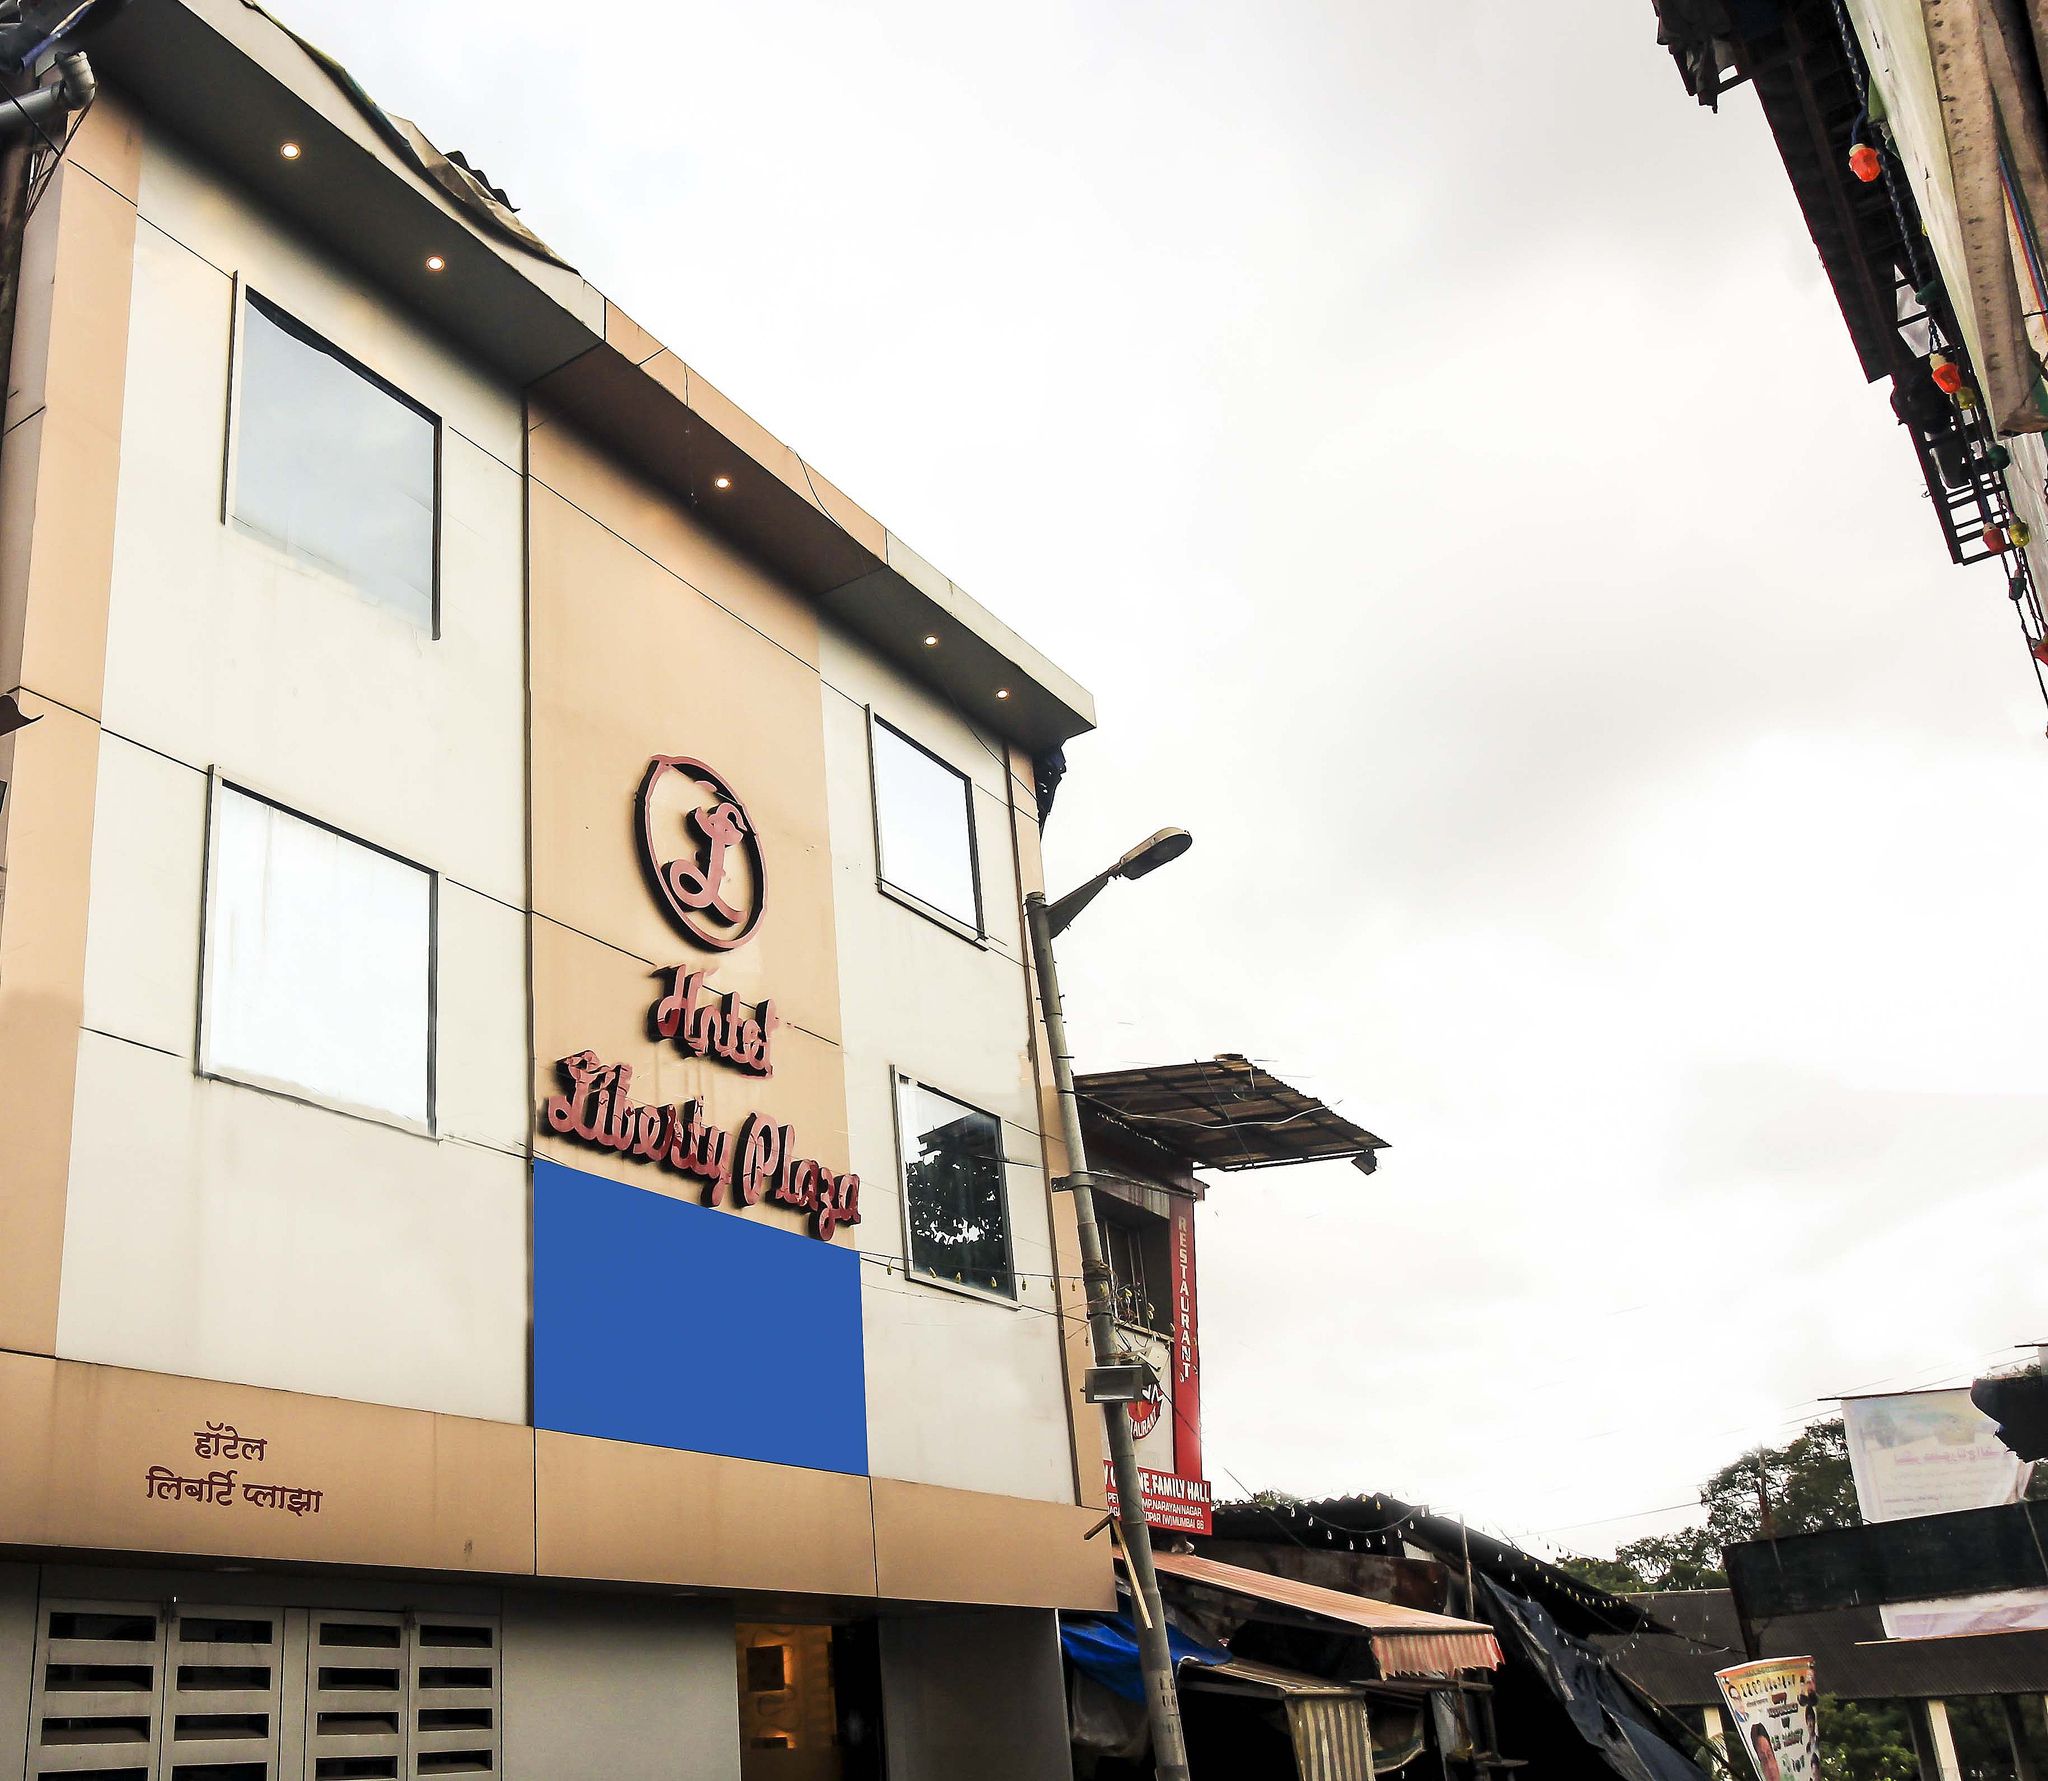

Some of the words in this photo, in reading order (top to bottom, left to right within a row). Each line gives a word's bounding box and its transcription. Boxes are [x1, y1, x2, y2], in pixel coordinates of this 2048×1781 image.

[545, 1049, 732, 1208] Liberty
[736, 1111, 861, 1242] Plaza
[1178, 1216, 1192, 1379] RESTAURANT
[193, 1420, 268, 1461] हॉटेल
[242, 1483, 324, 1517] प्लाझा
[1187, 1481, 1210, 1503] HALL
